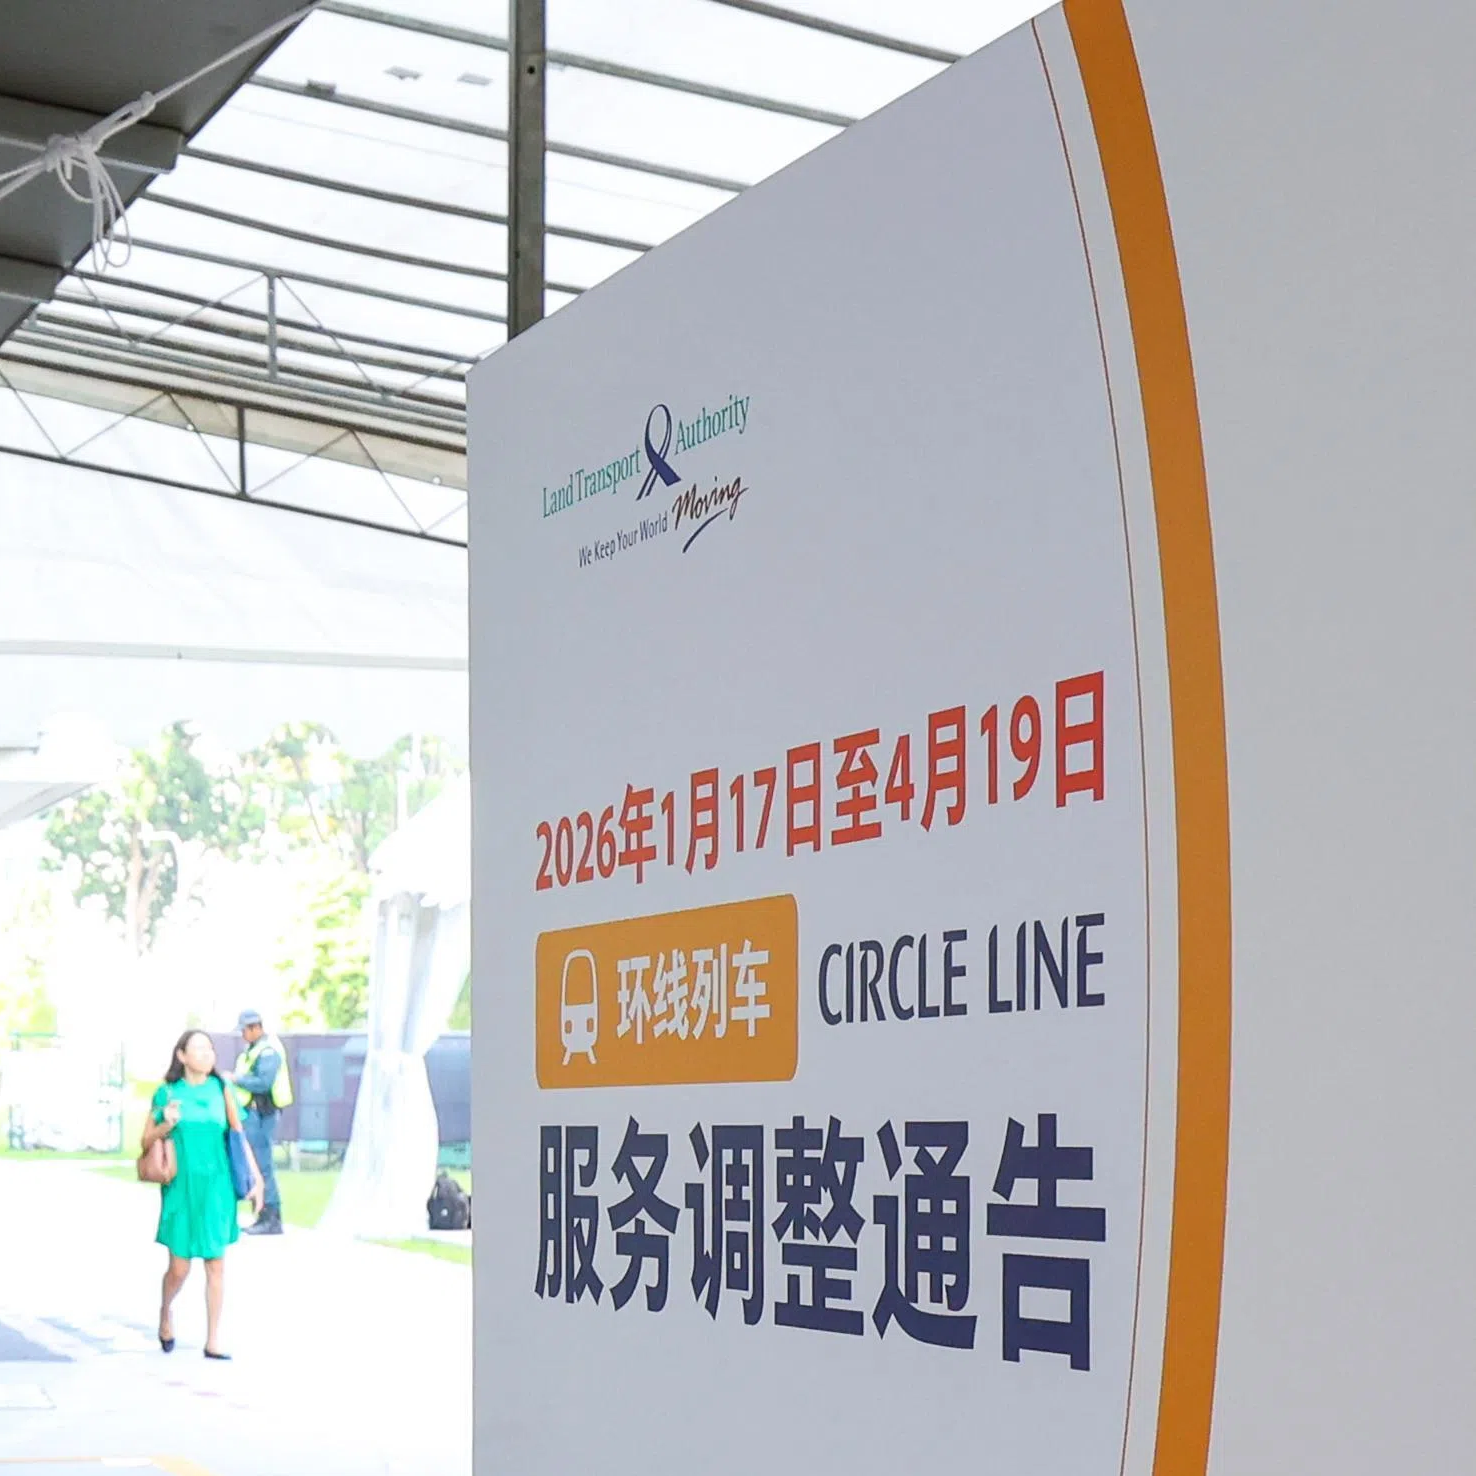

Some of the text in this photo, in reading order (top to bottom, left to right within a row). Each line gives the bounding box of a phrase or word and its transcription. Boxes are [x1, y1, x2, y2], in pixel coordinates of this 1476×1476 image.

[542, 394, 750, 519] Land Transport Authority
[578, 476, 749, 568] We Keep Your World Moving
[535, 669, 1105, 892] 2026年1月17日至4月19日
[616, 938, 771, 1046] 环线列车
[817, 912, 1106, 1027] CIRCLE LINE
[533, 1112, 1107, 1372] 服务调整通告
